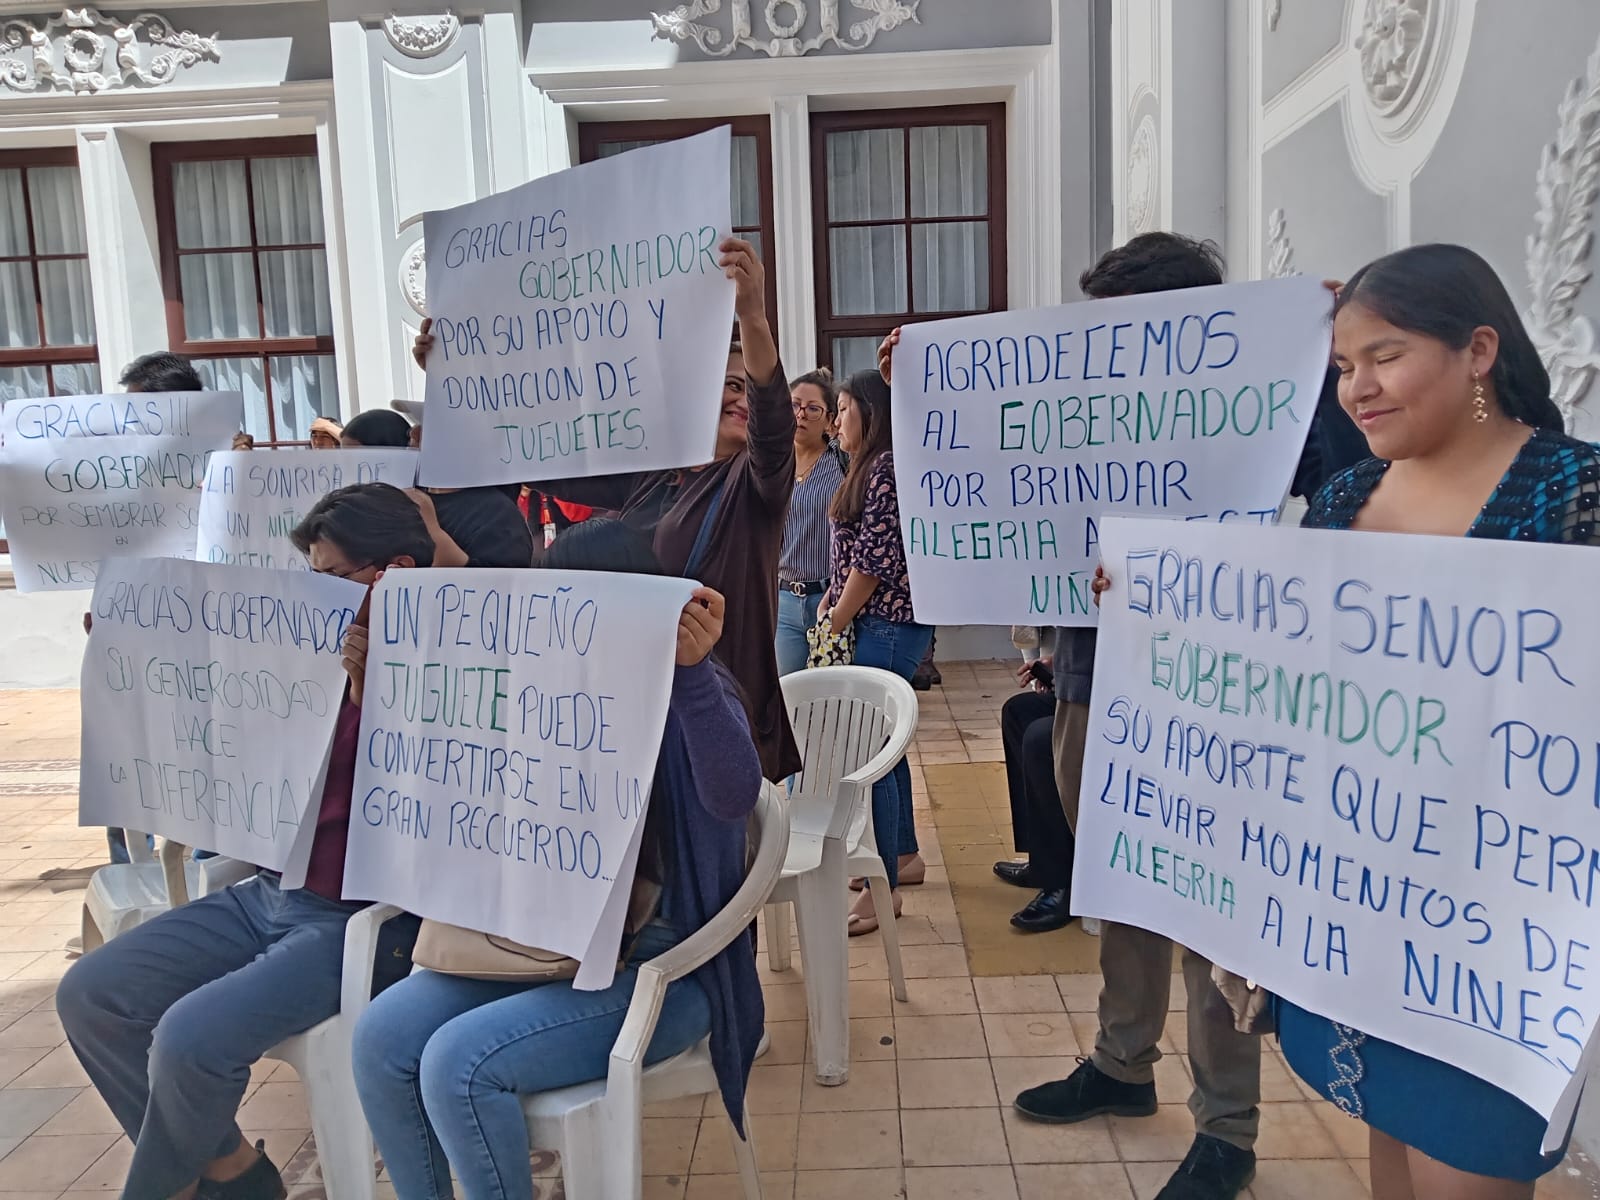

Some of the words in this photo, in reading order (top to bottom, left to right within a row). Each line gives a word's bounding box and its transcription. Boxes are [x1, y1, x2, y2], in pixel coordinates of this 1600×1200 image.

[445, 209, 568, 269] GRACIAS
[519, 225, 722, 302] GOBERNADOR
[435, 315, 487, 361] POR
[492, 313, 524, 356] SU
[536, 299, 629, 349] APOYO
[648, 298, 665, 340] Y
[923, 310, 1240, 394] AGRADECEMOS
[442, 365, 584, 412] DONACION
[595, 356, 642, 401] DE
[16, 397, 190, 439] GRACIAS!!!
[493, 408, 648, 465] JUGUETES.
[922, 409, 970, 451] AL
[1000, 379, 1300, 454] GOBERNADOR
[207, 464, 234, 494] LA
[249, 464, 343, 498] SONRISA
[920, 469, 988, 508] POR
[1010, 459, 1193, 508] BRINDAR
[18, 505, 64, 527] POR
[68, 502, 167, 529] SEMBRAR
[115, 535, 129, 545] EN
[226, 510, 250, 539] UN
[268, 507, 301, 538] NIÑ
[910, 515, 1058, 561] ALEGRIA
[97, 581, 193, 633] GRACIAS
[201, 590, 355, 656] GOBERNADOR
[383, 585, 422, 649] UN
[436, 583, 599, 657] PEQUEÑO
[1029, 571, 1090, 615] NIÑ
[1333, 578, 1576, 687] SENOR
[107, 647, 134, 692] SU
[145, 656, 328, 719] GENEROSIDAD
[381, 661, 512, 733] JUGUETE
[518, 685, 617, 753] PUEDE
[172, 711, 236, 757] HACE
[1151, 631, 1454, 767] GOBERNADOR
[1490, 720, 1600, 810] PO
[109, 763, 127, 783] LA
[368, 727, 541, 807] CONVERTIRSE
[559, 765, 596, 815] EN
[1102, 695, 1152, 754] SU
[1164, 714, 1306, 804] APORTE
[1331, 764, 1448, 855] QUE
[363, 786, 431, 840] GRAN
[1109, 831, 1235, 920] ALEGRIA
[1260, 895, 1282, 948] A
[1304, 915, 1350, 976] LA
[1241, 817, 1493, 945] MOMENTOS
[1523, 918, 1590, 991] DE
